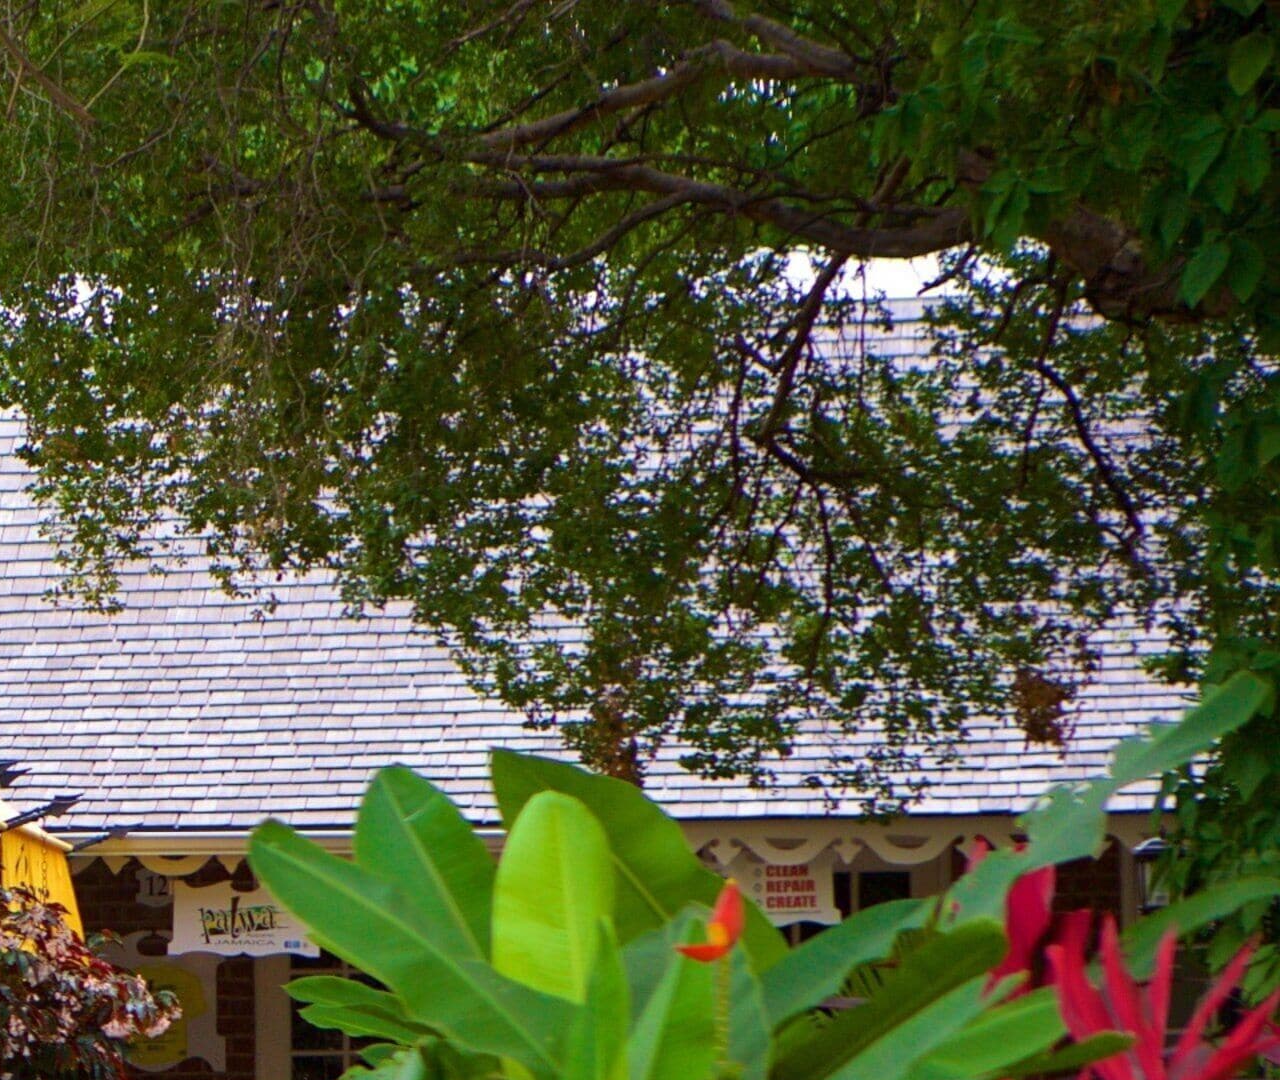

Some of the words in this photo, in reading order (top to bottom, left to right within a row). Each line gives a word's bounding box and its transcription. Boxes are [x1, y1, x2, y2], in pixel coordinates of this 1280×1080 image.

[766, 865, 809, 878] CLEAN
[146, 876, 168, 896] 12
[766, 879, 815, 893] REPAIR
[766, 895, 817, 909] CREATE
[214, 938, 276, 946] JAMAICA
